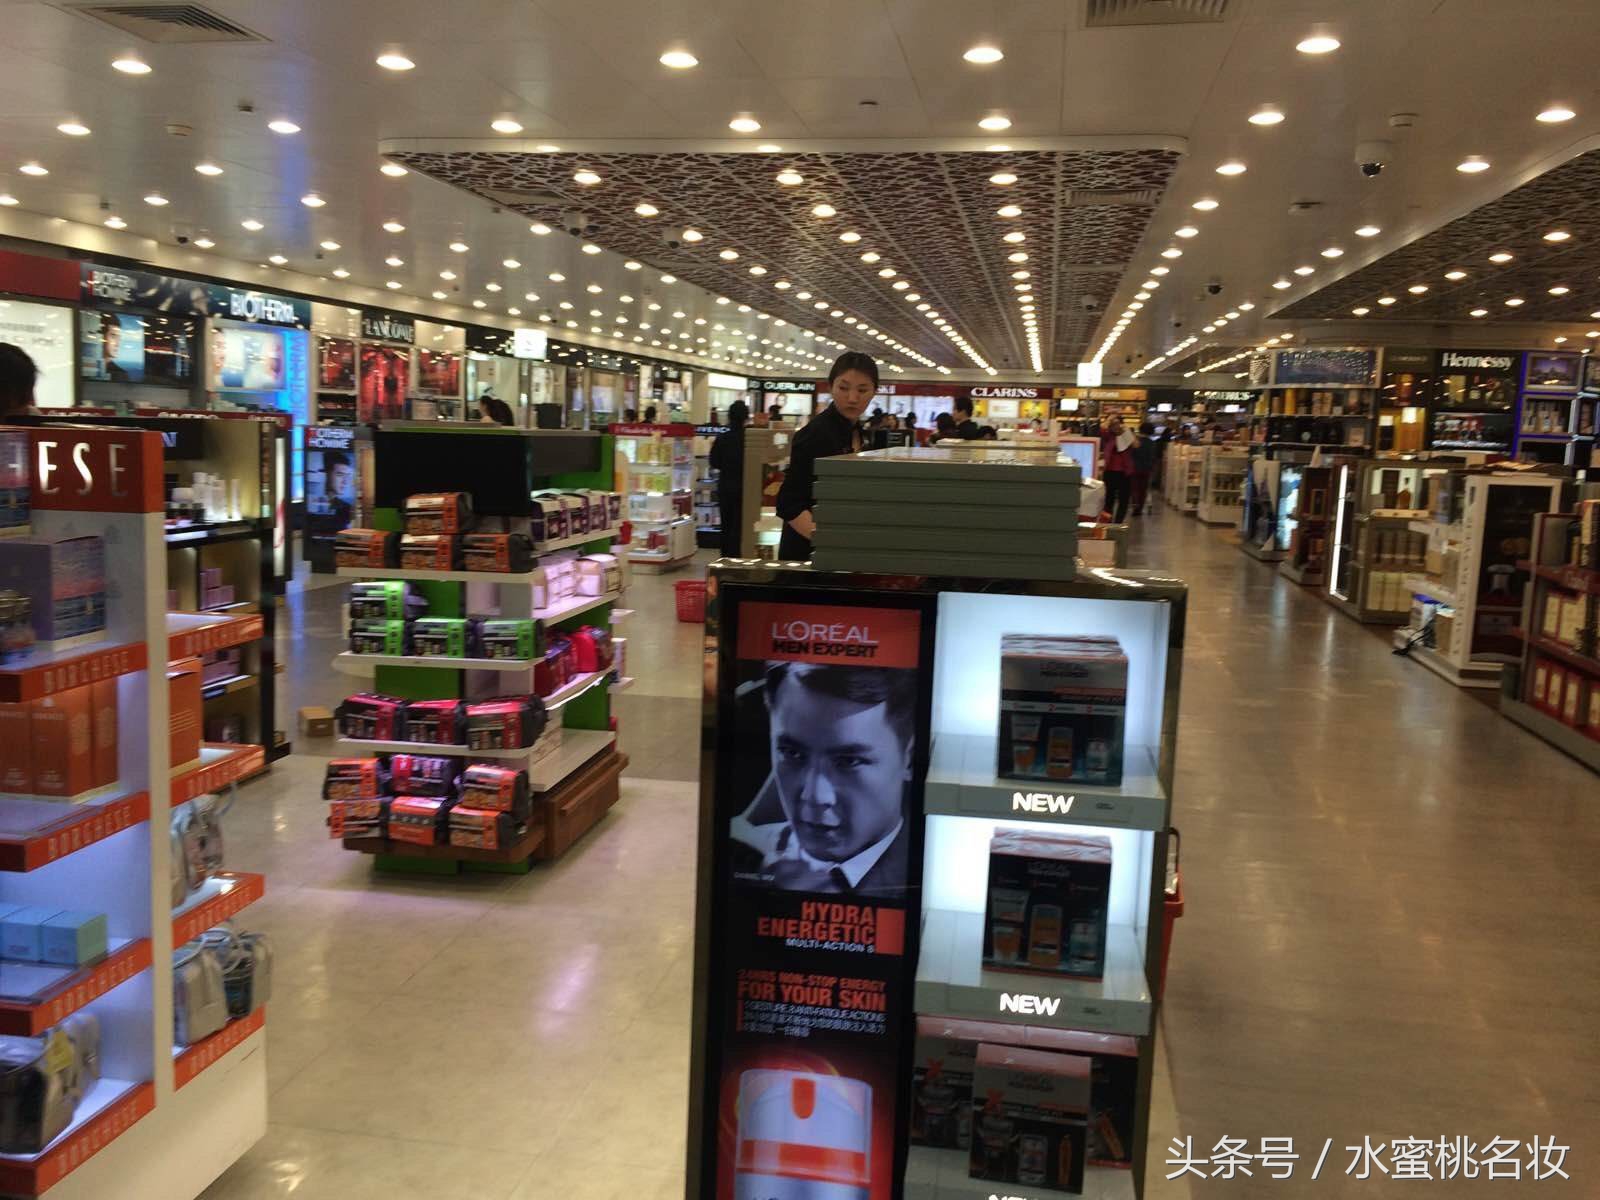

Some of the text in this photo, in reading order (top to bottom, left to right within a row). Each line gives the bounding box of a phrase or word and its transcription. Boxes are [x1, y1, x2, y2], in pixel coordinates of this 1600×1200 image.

[1442, 352, 1515, 371] Hennessy
[971, 387, 1038, 398] CLARINS
[771, 620, 879, 643] L'ORÉAL
[772, 640, 878, 658] MEN EXPERT
[1012, 792, 1075, 814] NEW
[48, 805, 132, 860] BORGHESE
[802, 901, 874, 925] HYDRA
[758, 917, 875, 945] ENERGETIC
[786, 938, 864, 953] MULTI-ACTION
[52, 954, 136, 1021] BORGHESE
[736, 981, 775, 1000] FOR
[780, 984, 833, 1007] YOUR
[838, 989, 886, 1012] SKIN
[1000, 993, 1060, 1016] NEW
[56, 1100, 138, 1176] BORGHESE
